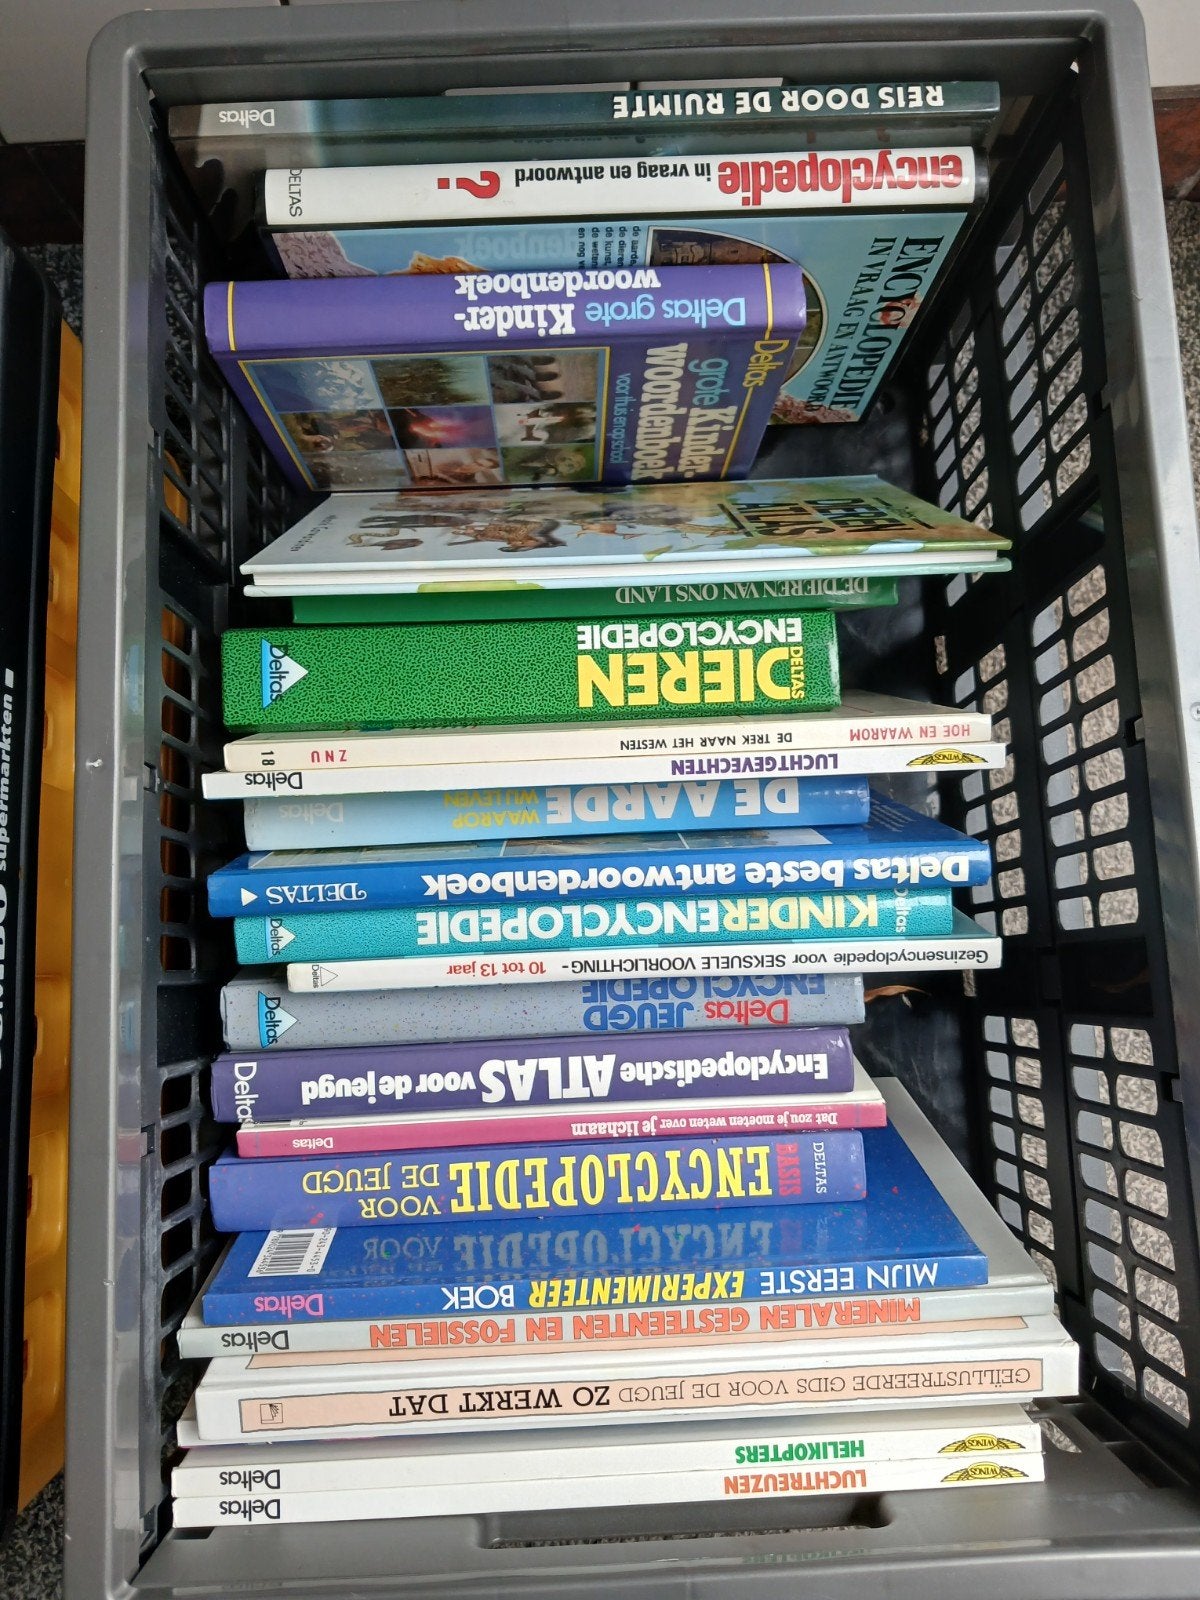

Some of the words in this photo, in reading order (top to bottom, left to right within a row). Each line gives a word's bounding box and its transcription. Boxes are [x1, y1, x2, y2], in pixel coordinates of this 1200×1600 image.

[612, 93, 724, 119] RUIMTE
[735, 91, 772, 114] DE
[781, 87, 869, 112] DOOR
[878, 85, 944, 108] REIS
[219, 108, 275, 128] Deltas
[515, 165, 604, 187] antwoord
[609, 164, 632, 181] en
[637, 162, 689, 180] vraag
[695, 163, 711, 181] in
[718, 149, 963, 206] encyclopedie
[868, 237, 897, 256] IN
[455, 269, 661, 300] woordenboek
[843, 260, 886, 318] VRAAG
[454, 304, 575, 337] Kinder-
[585, 294, 655, 326] grote
[661, 297, 746, 328] Deltas
[827, 235, 944, 410] ENCYCLOPEDIE
[833, 321, 859, 340] EN
[742, 340, 790, 388] Deltas
[616, 373, 630, 395] voor
[688, 358, 730, 406] grote
[615, 396, 636, 415] thuis
[631, 343, 688, 480] woordenboek
[614, 416, 628, 428] en
[615, 585, 671, 604] LAND
[675, 583, 719, 602] ONS
[722, 582, 759, 599] VAN
[762, 578, 839, 597] DIEREN
[841, 577, 869, 594] DE
[577, 617, 802, 650] ENCYCLOPEDIE
[269, 643, 288, 702] Deltas
[577, 646, 791, 707] DIEREN
[789, 645, 803, 700] DELTAS
[672, 737, 694, 750] HET
[700, 736, 736, 749] NAAR
[742, 734, 770, 747] TREK
[777, 733, 792, 745] DE
[849, 727, 913, 742] WAAROM
[919, 726, 937, 740] EN
[943, 724, 970, 740] HOE
[620, 738, 668, 751] WESTEN
[261, 750, 274, 766] 18
[671, 753, 838, 775] LUCHTGEVECHTEN
[935, 752, 960, 763] WINGS
[244, 771, 303, 790] Deltas
[444, 791, 501, 808] LEVEN
[505, 789, 539, 805] WIJ
[545, 779, 720, 824] AARDE
[735, 777, 799, 815] DE
[278, 802, 344, 825] Deltas
[452, 810, 540, 829] WAAROP
[421, 862, 736, 900] antwoordenboek
[745, 858, 844, 888] beste
[853, 855, 969, 885] Deltas
[266, 882, 367, 905] DELTAS
[416, 894, 879, 945] KINDERENCYCLOPEDIE
[271, 918, 282, 956] Deltas
[528, 962, 546, 975] 10
[701, 954, 786, 969] SEKSUELE
[792, 954, 826, 965] voor
[834, 948, 988, 966] Gezinsencyclopedie
[446, 962, 476, 978] jaar
[480, 963, 498, 977] 13
[502, 962, 525, 976] tot
[582, 974, 826, 1003] ENCYCLOPEDIE
[265, 997, 282, 1046] Deltas
[583, 1002, 694, 1030] JEUGD
[704, 1000, 789, 1026] Deltas
[478, 1054, 616, 1103] ATLAS
[620, 1050, 828, 1086] Encyclopedische
[301, 1071, 376, 1105] jeugd
[380, 1075, 412, 1100] de
[416, 1071, 476, 1094] voor
[571, 1121, 639, 1138] lichaam
[642, 1115, 657, 1135] je
[660, 1118, 687, 1130] over
[690, 1116, 727, 1129] weten
[730, 1113, 775, 1129] moeten
[777, 1111, 790, 1128] je
[790, 1113, 812, 1124] zou
[815, 1112, 837, 1125] Dat
[292, 1137, 334, 1150] Deltas
[302, 1162, 392, 1194] JEUGD
[401, 1163, 440, 1188] DE
[449, 1145, 772, 1213] ENCYCLOPEDIE
[776, 1143, 802, 1196] BASIS
[813, 1142, 825, 1194] DELTAS
[358, 1195, 441, 1219] VOOR
[760, 1267, 854, 1295] EERSTE
[866, 1262, 939, 1289] MIJN
[441, 1284, 515, 1311] BOEK
[528, 1270, 745, 1308] EXPERIMENTEER
[253, 1293, 324, 1319] Deltas
[759, 1297, 921, 1331] MINERALEN
[369, 1318, 516, 1349] FOSSIELEN
[526, 1317, 563, 1343] EN
[573, 1306, 750, 1340] GESTEENTEN
[221, 1330, 290, 1352] Deltas
[692, 1382, 720, 1399] DE
[728, 1380, 788, 1397] VOOR
[796, 1376, 846, 1394] GIDS
[853, 1367, 1031, 1391] GEÏLLUSTREERDE
[458, 1389, 562, 1414] WERKT
[572, 1385, 610, 1407] ZO
[618, 1380, 686, 1403] JEUGD
[389, 1394, 449, 1417] DAT
[735, 1440, 865, 1464] HELIKOPTERS
[967, 1438, 995, 1450] WINGS
[219, 1469, 281, 1490] Deltas
[724, 1469, 867, 1494] LUCHTREUZEN
[969, 1465, 997, 1478] WINGS
[219, 1499, 281, 1522] Deltas
